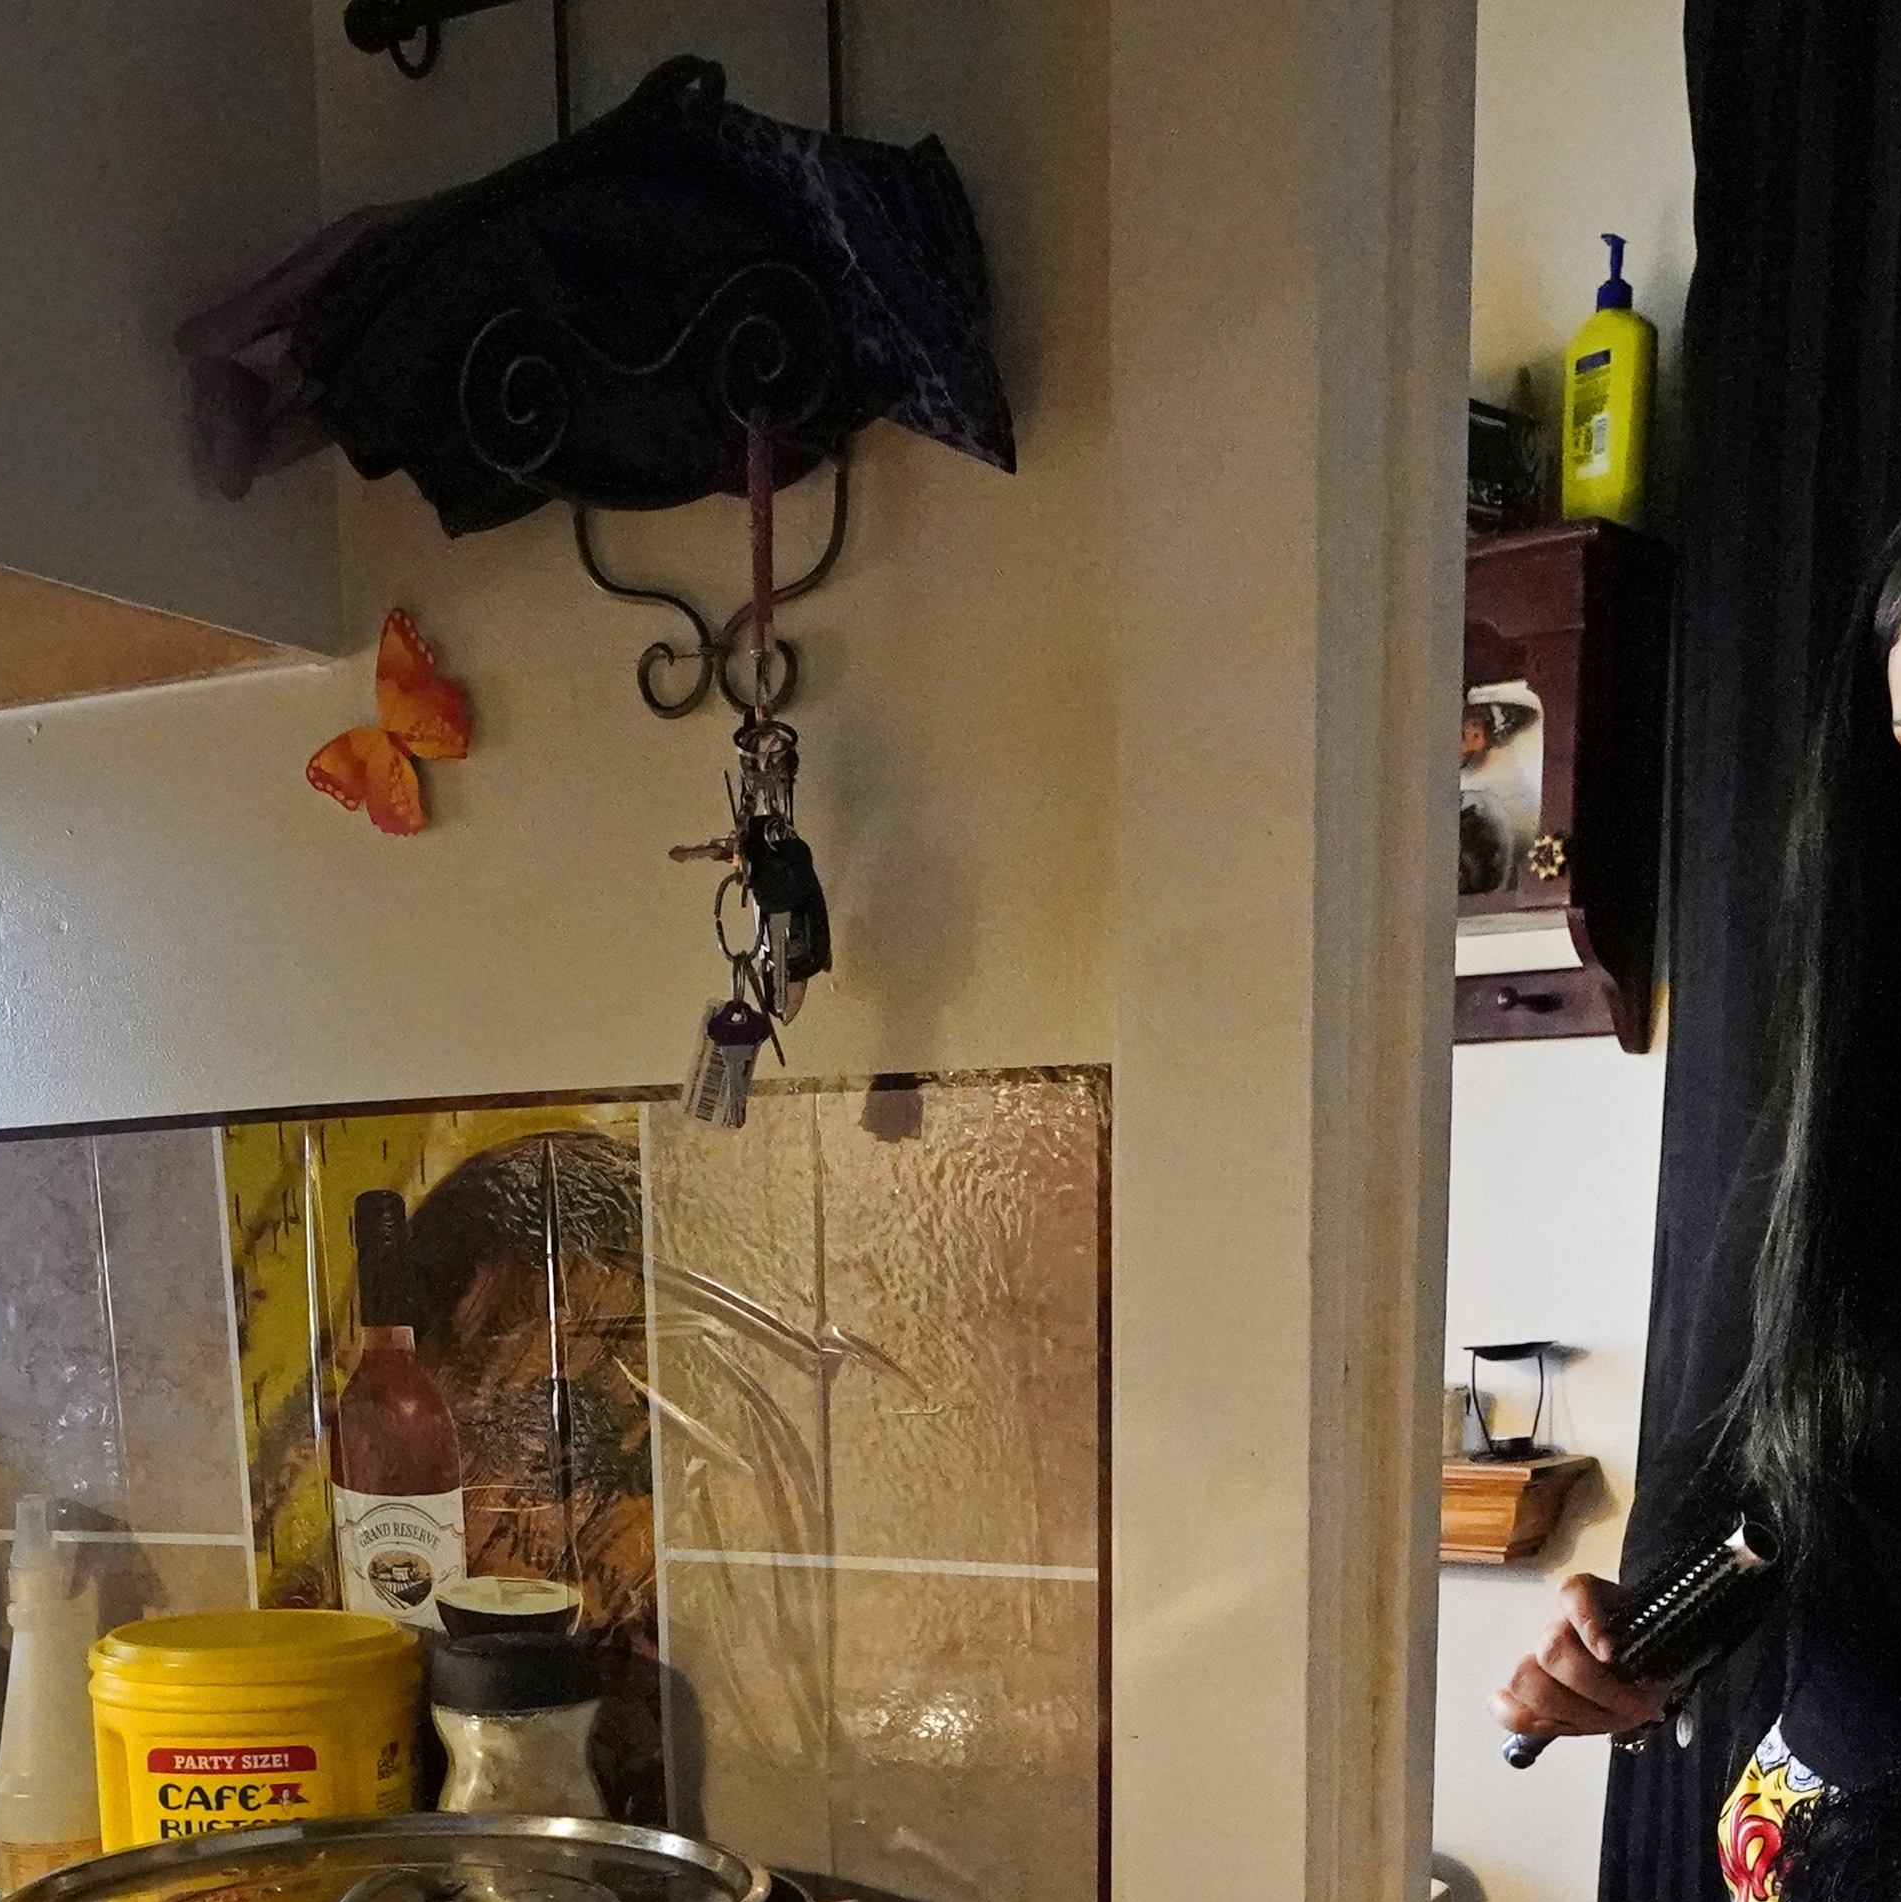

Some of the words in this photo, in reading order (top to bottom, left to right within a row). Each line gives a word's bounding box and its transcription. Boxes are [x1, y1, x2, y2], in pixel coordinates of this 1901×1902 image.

[359, 1523, 391, 1548] GRAND
[393, 1522, 441, 1552] RESERVE
[173, 1754, 236, 1771] PARTY
[241, 1753, 289, 1770] SIZE!
